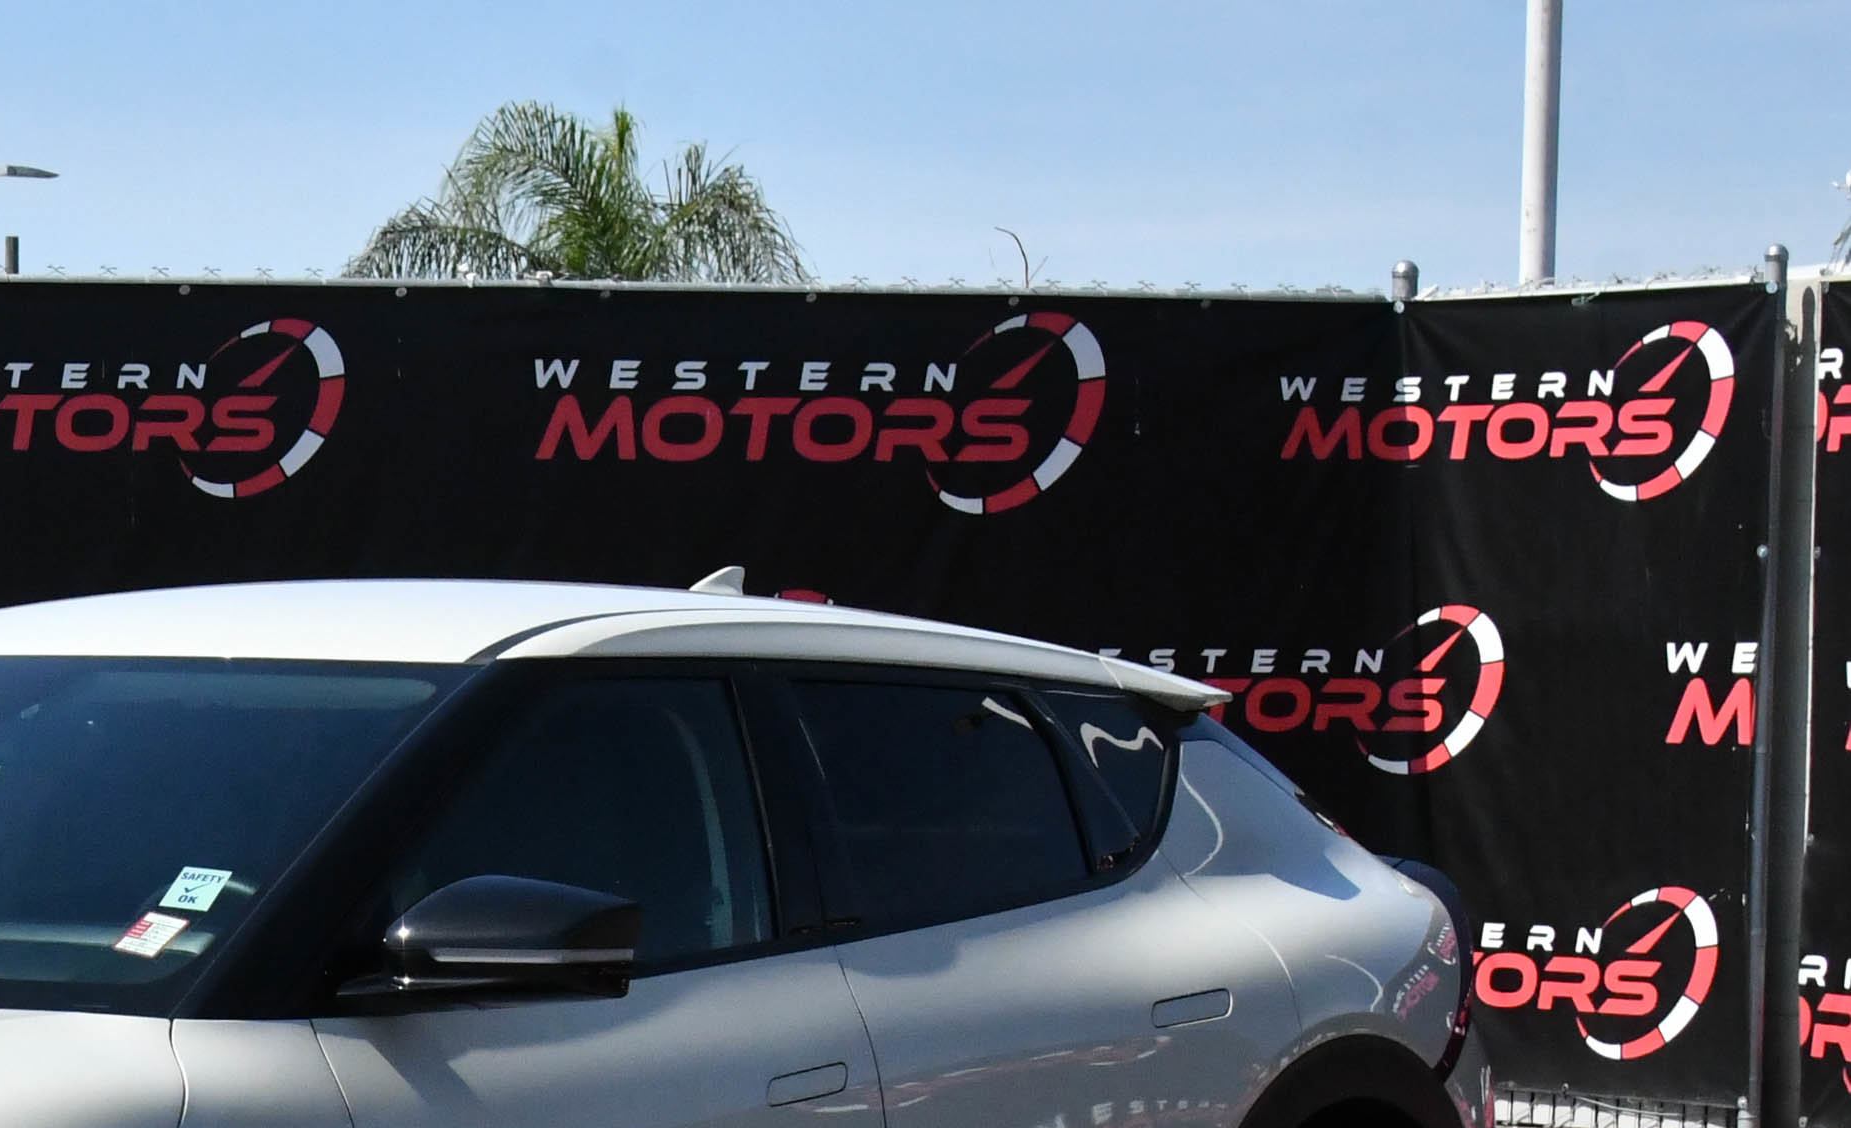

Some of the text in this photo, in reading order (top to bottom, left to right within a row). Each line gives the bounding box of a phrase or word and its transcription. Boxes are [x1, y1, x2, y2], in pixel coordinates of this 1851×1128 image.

[534, 358, 957, 392] WESTERN
[1280, 369, 1615, 402] WESTERN
[535, 395, 1031, 462] MOTORS
[1280, 397, 1677, 461] MOTORS
[180, 871, 226, 884] SAFETY
[177, 894, 198, 904] OK
[1471, 950, 1663, 1017] ORS
